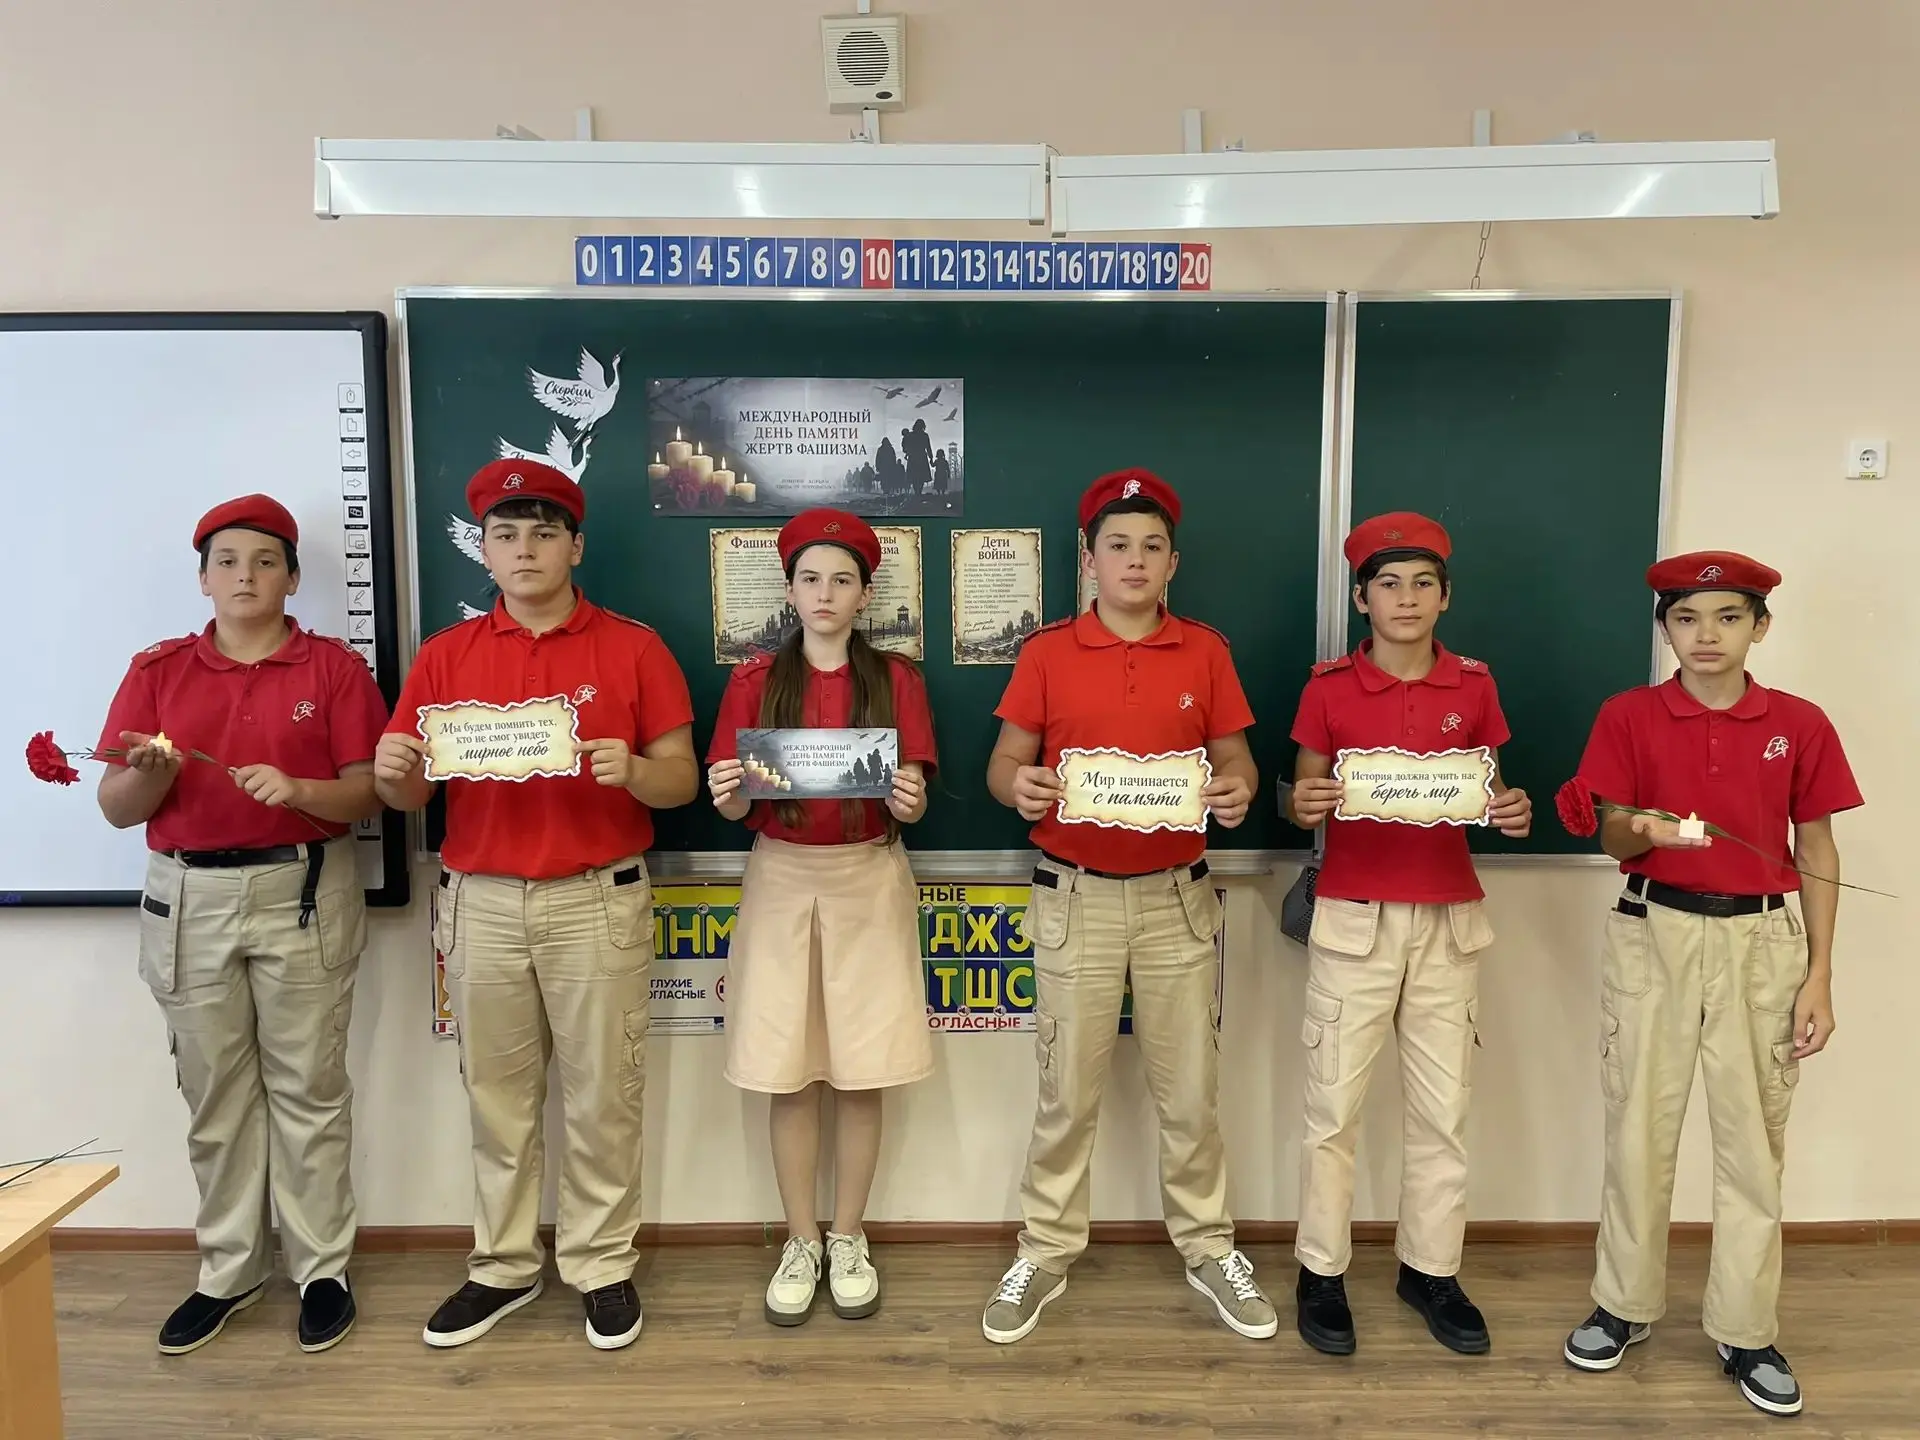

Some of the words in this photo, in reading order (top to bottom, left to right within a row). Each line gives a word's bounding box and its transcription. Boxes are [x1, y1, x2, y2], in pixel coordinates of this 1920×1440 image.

[582, 244, 598, 277] 0
[611, 245, 623, 276] 1
[639, 245, 654, 276] 2
[668, 245, 682, 277] 3
[696, 245, 714, 277] 4
[726, 246, 740, 278] 5
[754, 246, 770, 279] 6
[783, 246, 798, 279] 7
[811, 246, 828, 280] 8
[840, 247, 856, 280] 9
[866, 248, 891, 281] 10
[897, 248, 920, 281] 11
[929, 248, 955, 281] 12
[961, 249, 986, 282] 13
[993, 250, 1019, 283] 14
[1025, 250, 1050, 283] 15
[1057, 250, 1083, 284] 16
[1089, 251, 1115, 284] 17
[1120, 251, 1147, 284] 18
[1152, 251, 1178, 284] 19
[1181, 251, 1209, 285] 20
[544, 380, 594, 398] Скорбим
[739, 408, 871, 424] МЕЖДУНАРОДНЫЙ
[754, 427, 793, 440] ДЕНЬ
[798, 427, 858, 440] ПАМЯТИ
[745, 443, 793, 455] ЖЕРТВ
[797, 443, 867, 456] ФАШИЗМА
[981, 536, 1010, 549] Дети
[978, 548, 1016, 560] войны
[439, 722, 461, 734] Мы
[464, 722, 492, 733] будем
[494, 720, 536, 730] помнить
[538, 719, 557, 728] тех,
[456, 736, 472, 745] кто
[475, 735, 487, 743] не
[488, 733, 511, 743] смог
[512, 731, 551, 744] увидеть
[459, 746, 513, 766] мирное
[517, 739, 549, 758] небо
[782, 744, 852, 752] МЕЖДУНАРОДНЫЙ
[790, 752, 811, 760] ДЕНЬ
[813, 752, 845, 760] ПАМЯТИ
[1080, 771, 1115, 788] Мир
[1120, 775, 1189, 788] начинается
[1351, 771, 1392, 783] История
[1394, 772, 1429, 783] должна
[1432, 772, 1459, 783] учить
[1461, 772, 1477, 781] нас
[1093, 791, 1104, 805] с
[1107, 791, 1183, 806] памяти
[1370, 782, 1422, 805] беречь
[1424, 785, 1462, 805] мир
[919, 887, 966, 902] НЫЕ
[650, 978, 693, 988] ГЛУХИЕ
[928, 1016, 1021, 1029] ОГЛАСНЫЕ
